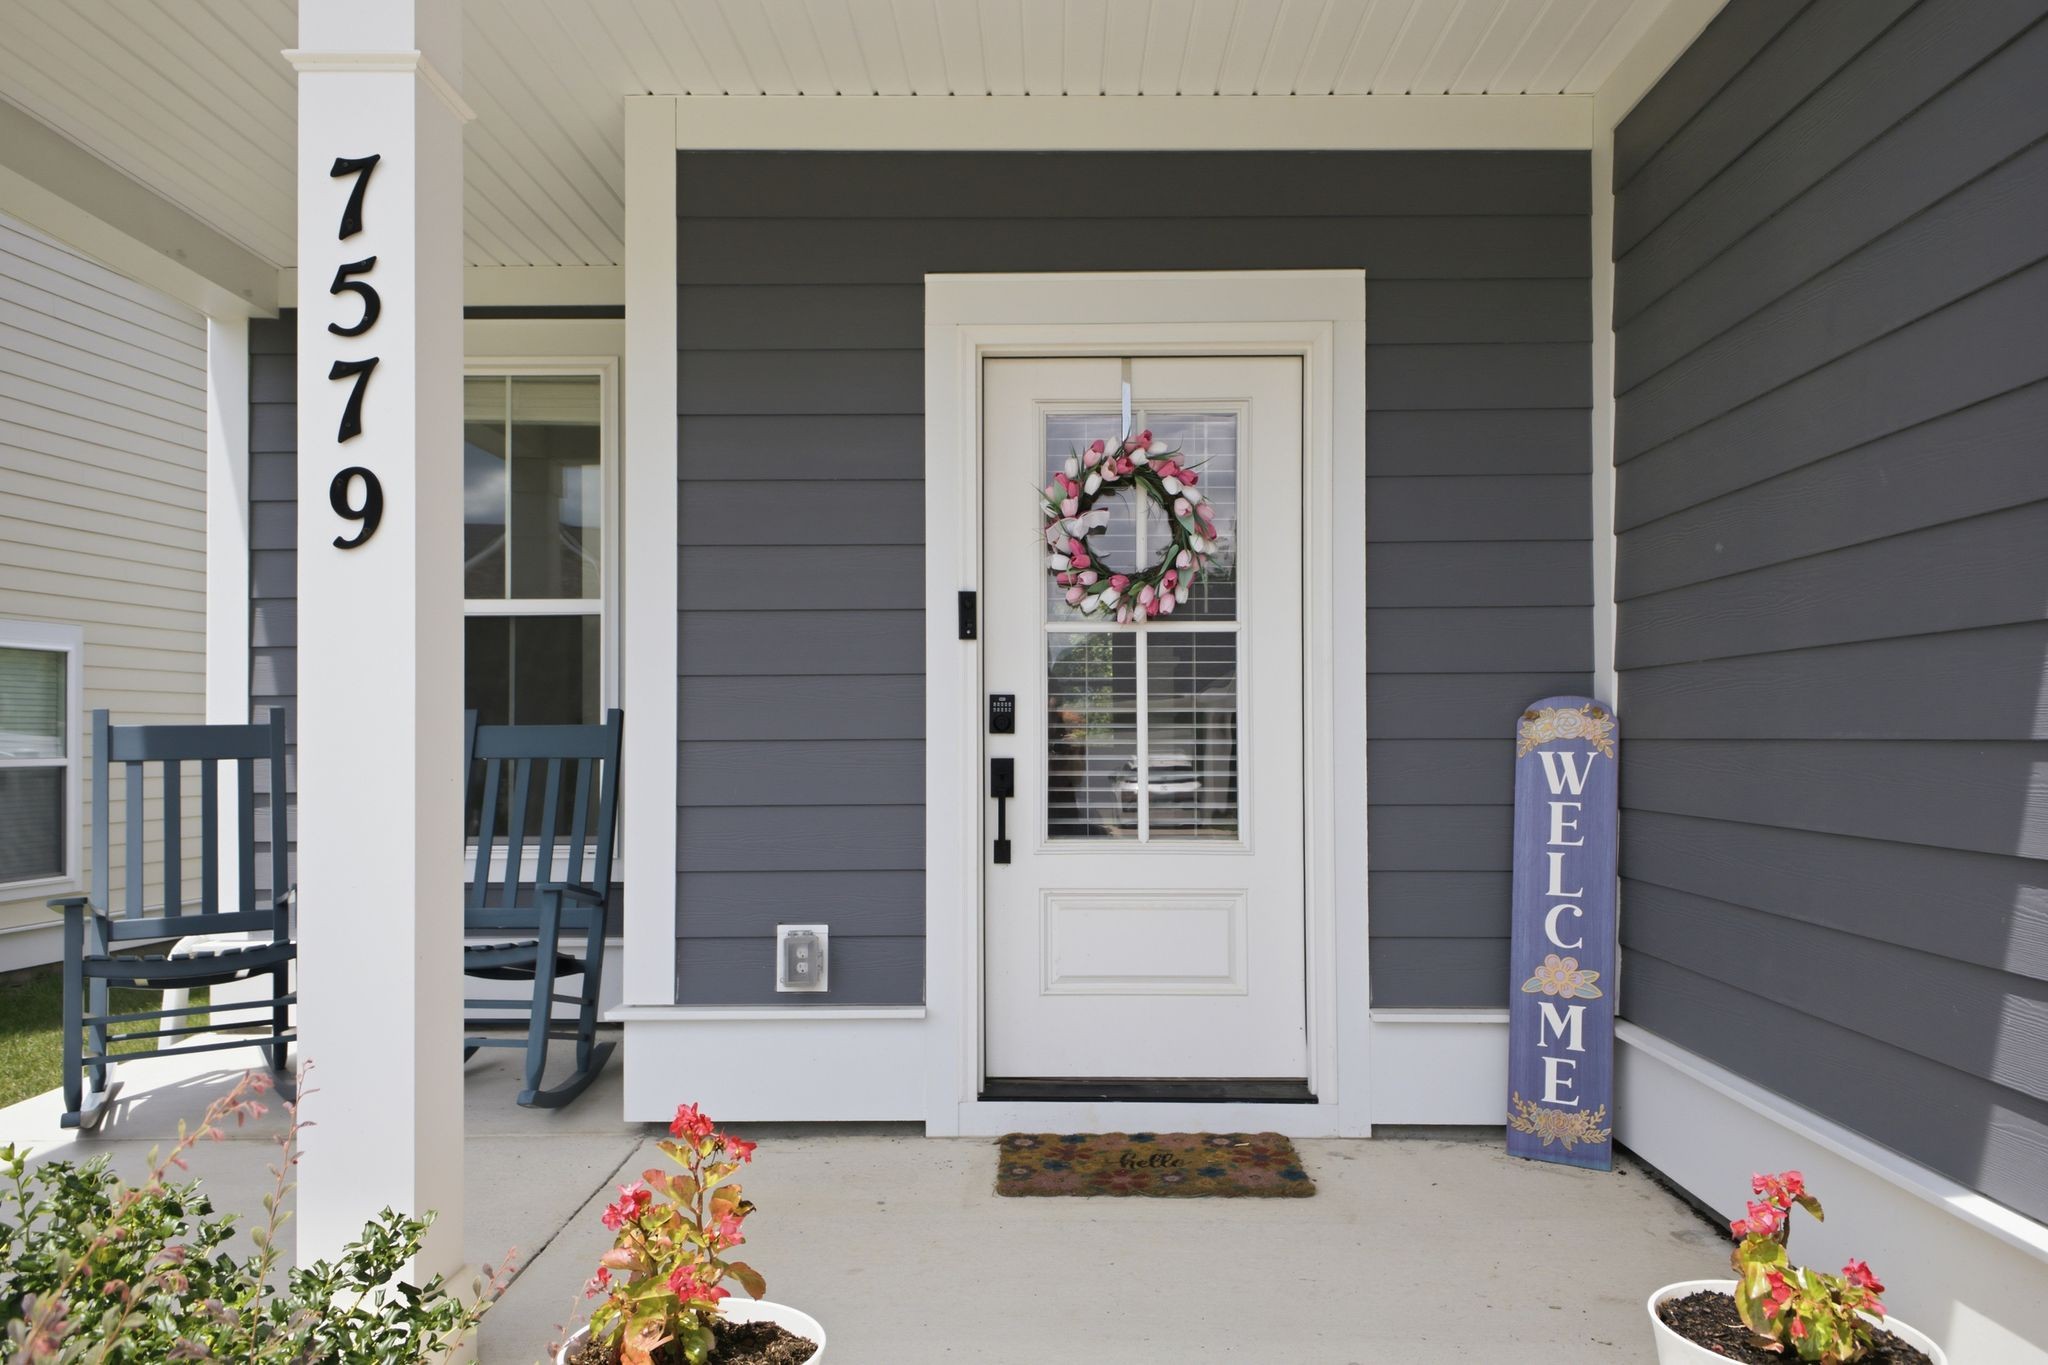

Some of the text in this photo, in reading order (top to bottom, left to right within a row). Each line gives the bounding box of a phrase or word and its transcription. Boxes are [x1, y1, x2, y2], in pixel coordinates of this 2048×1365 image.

[328, 153, 384, 550] 7579
[1537, 750, 1598, 1107] WELCME
[1109, 1152, 1191, 1169] hello
